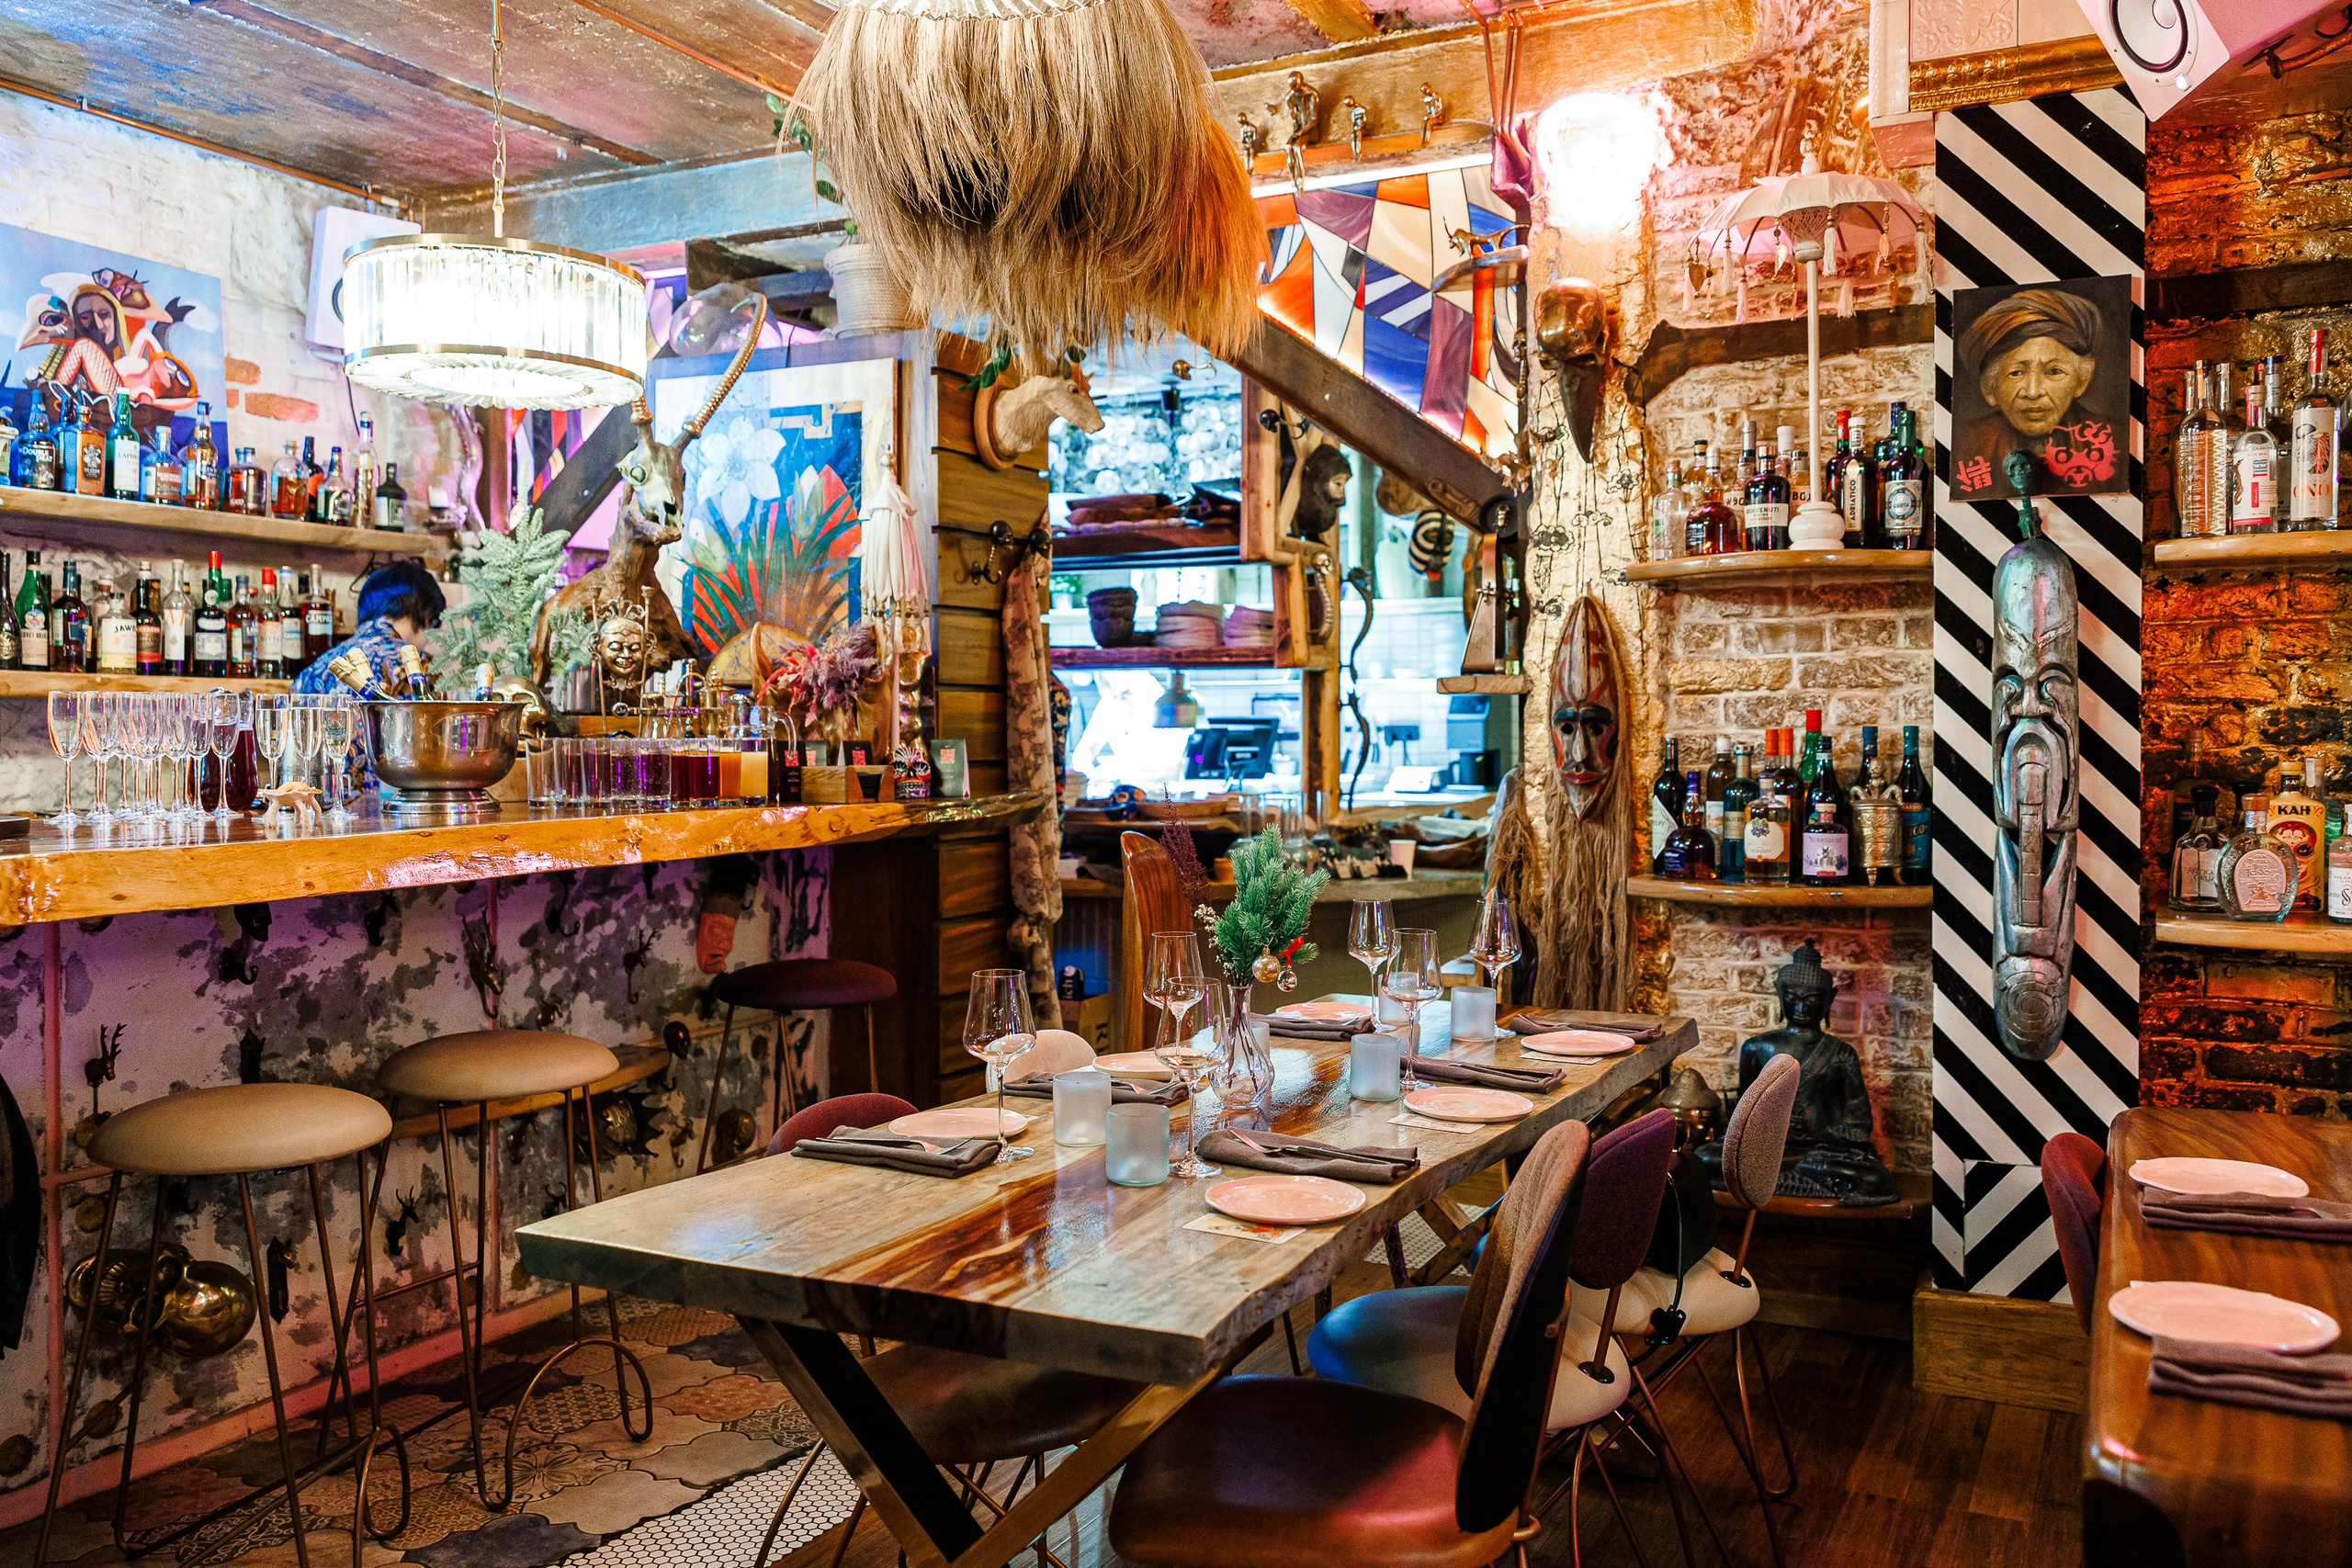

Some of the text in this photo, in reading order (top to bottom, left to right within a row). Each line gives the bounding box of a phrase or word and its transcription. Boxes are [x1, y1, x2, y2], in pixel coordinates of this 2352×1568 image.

[2253, 458, 2267, 478] TIER
[1747, 506, 1780, 514] BENVENUTI
[2278, 805, 2311, 816] KAH
